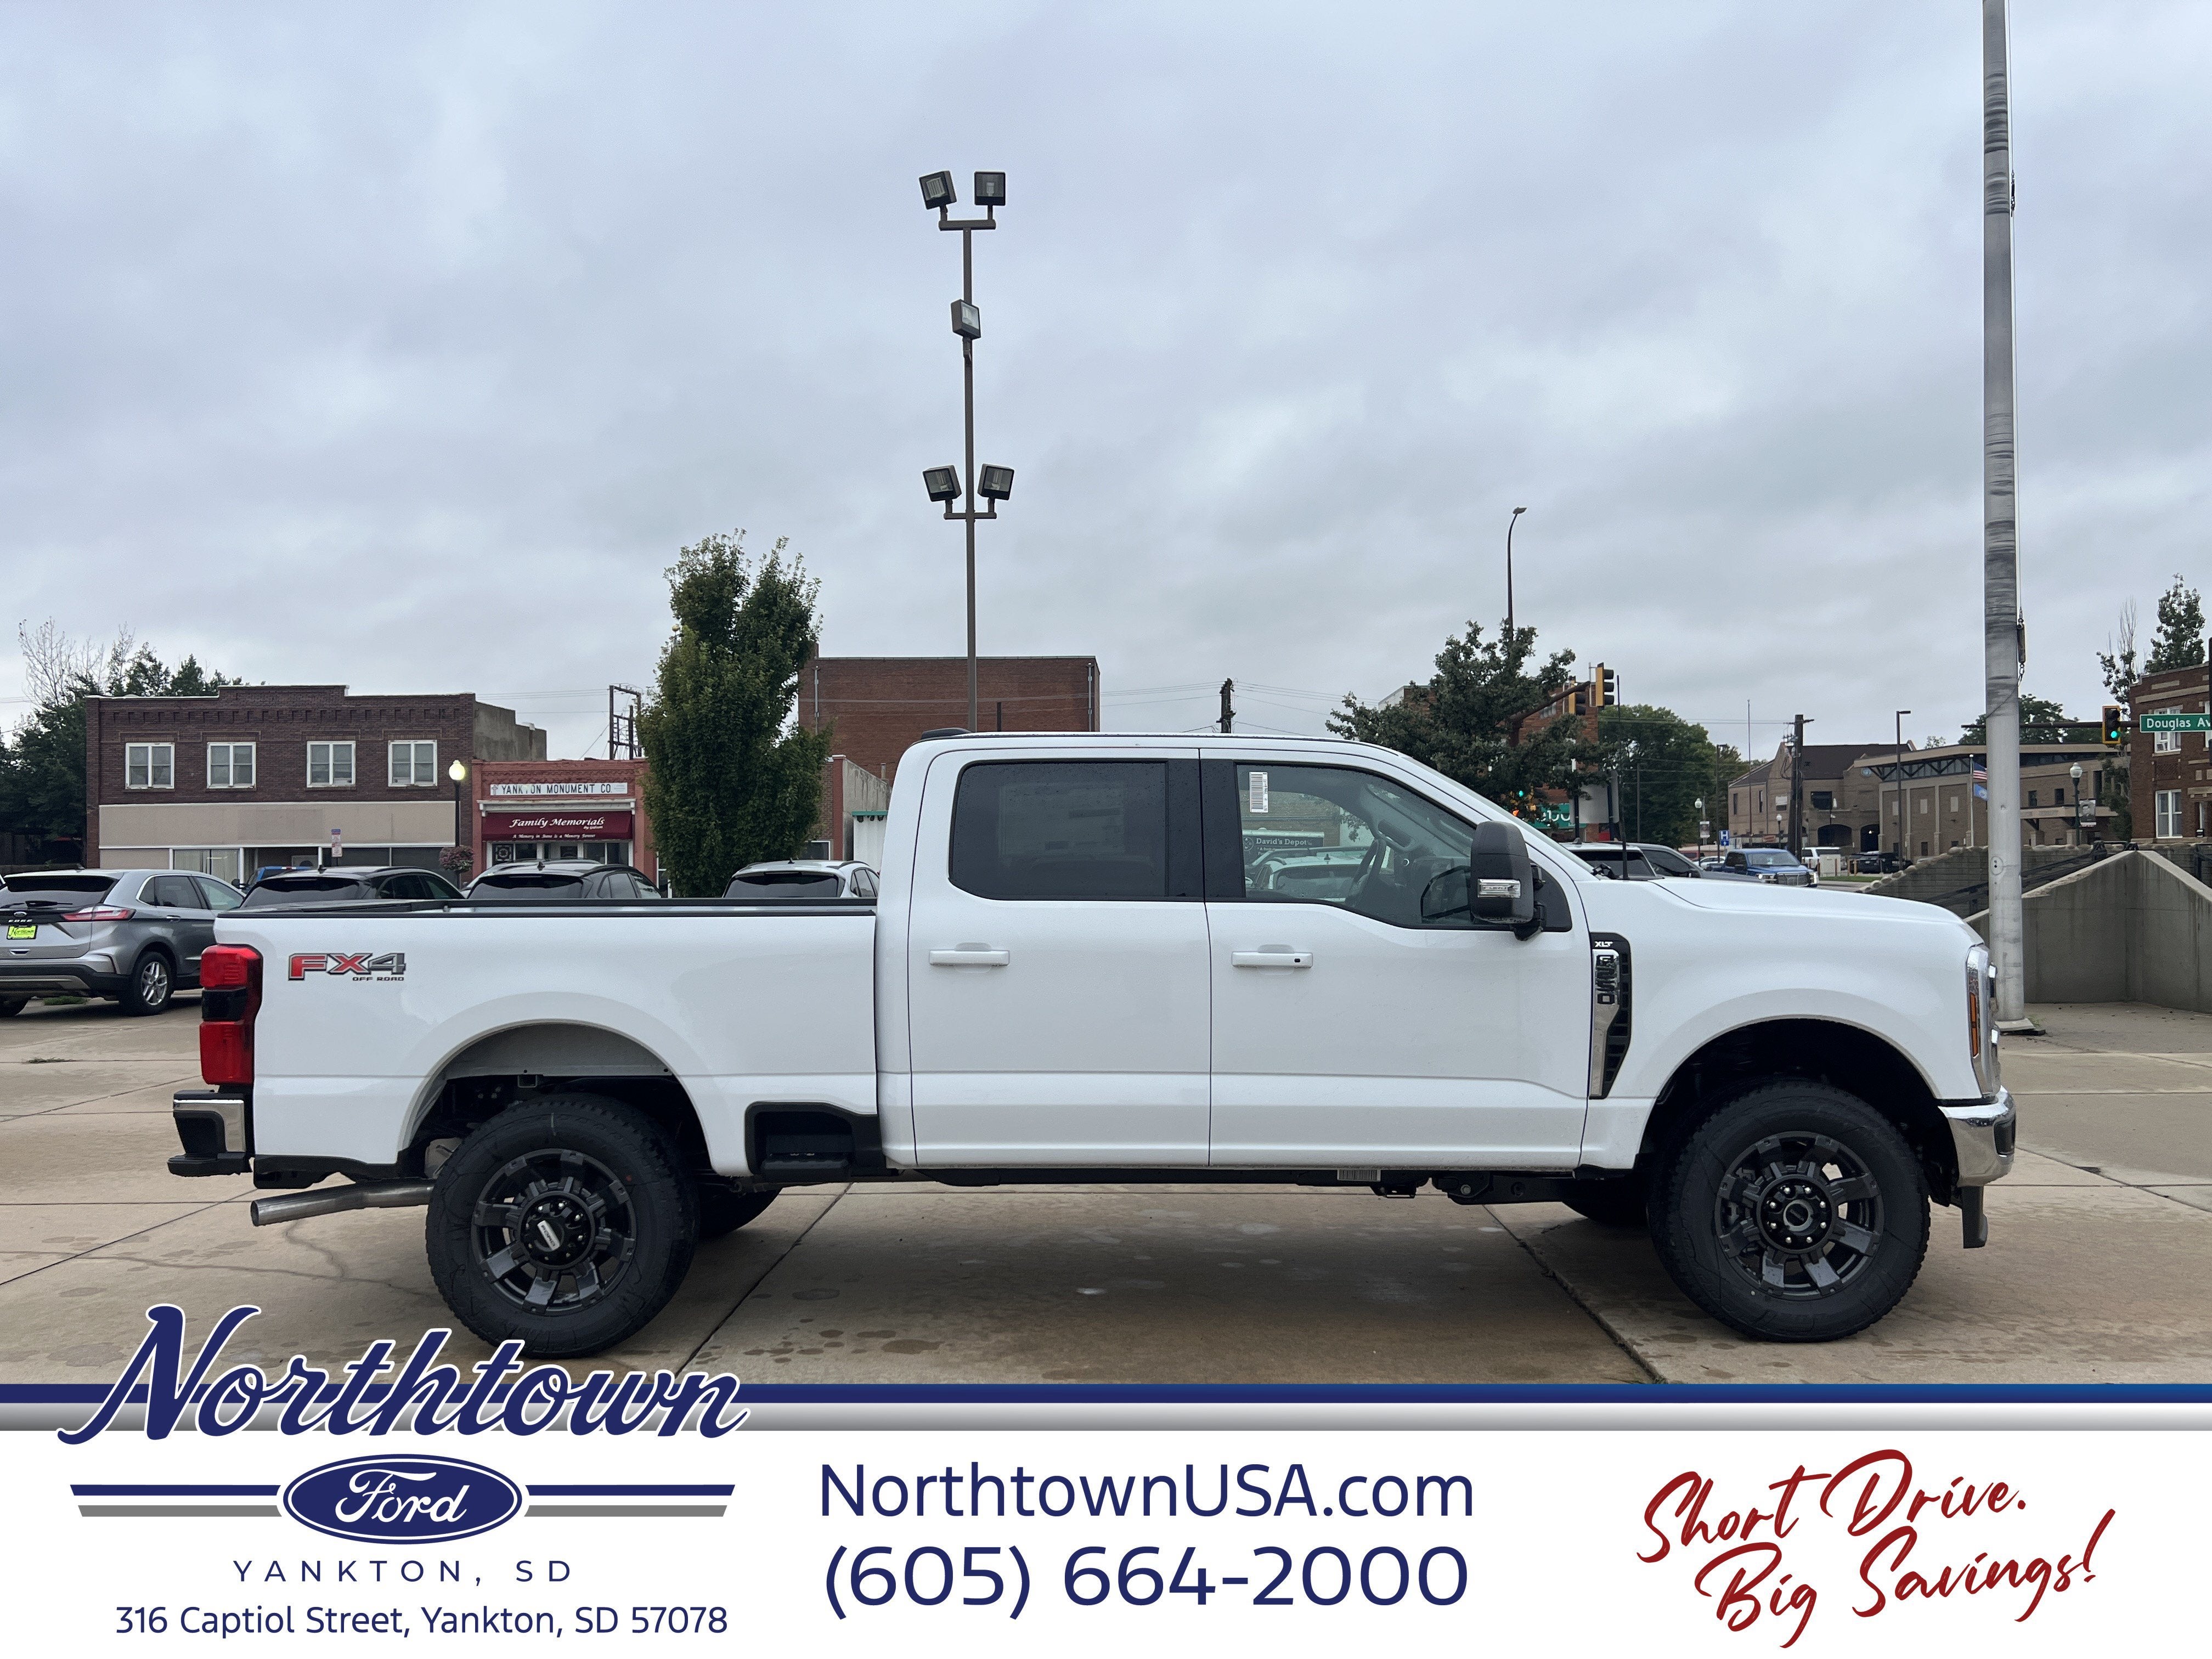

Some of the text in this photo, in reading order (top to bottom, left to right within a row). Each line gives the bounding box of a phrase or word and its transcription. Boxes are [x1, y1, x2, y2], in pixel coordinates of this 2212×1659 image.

[2147, 718, 2191, 730] Douglas
[547, 783, 595, 794] MONUMENT
[509, 816, 605, 828] Family Memorials
[1284, 838, 1307, 847] Depot
[289, 953, 406, 981] FX4
